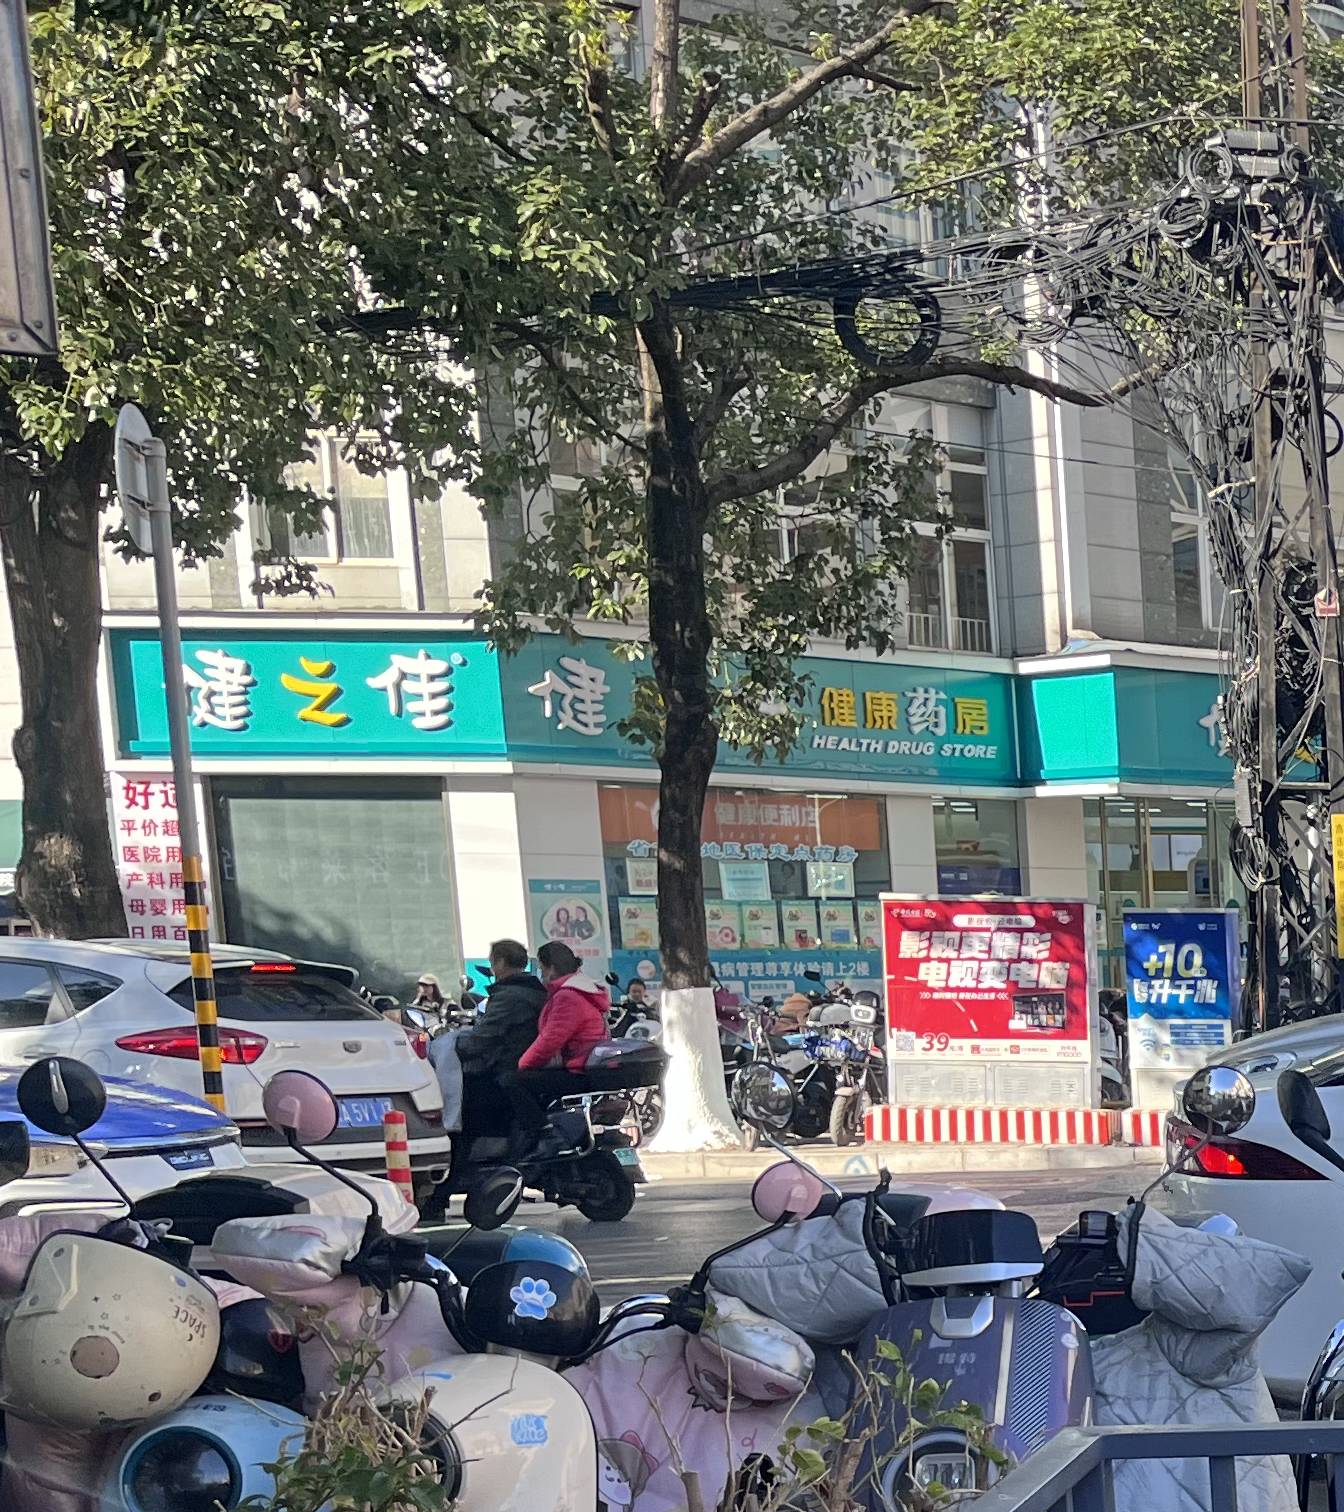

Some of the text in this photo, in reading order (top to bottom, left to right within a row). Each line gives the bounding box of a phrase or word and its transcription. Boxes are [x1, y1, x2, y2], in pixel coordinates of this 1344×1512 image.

[178, 649, 453, 731] 健之佳
[528, 656, 612, 737] 健
[820, 686, 990, 737] 健康药房
[811, 734, 998, 760] HEALTH DRUG STORE
[120, 819, 181, 837] 平价超
[122, 846, 183, 863] 医院用
[126, 872, 186, 889] 产科用
[129, 898, 187, 916] 母婴用
[131, 925, 188, 939] 日用百
[899, 931, 1051, 959] 影视更精彩
[918, 961, 1070, 989] 电视变电脑
[921, 1033, 950, 1053] 39
[172, 1305, 207, 1339] SPACE
